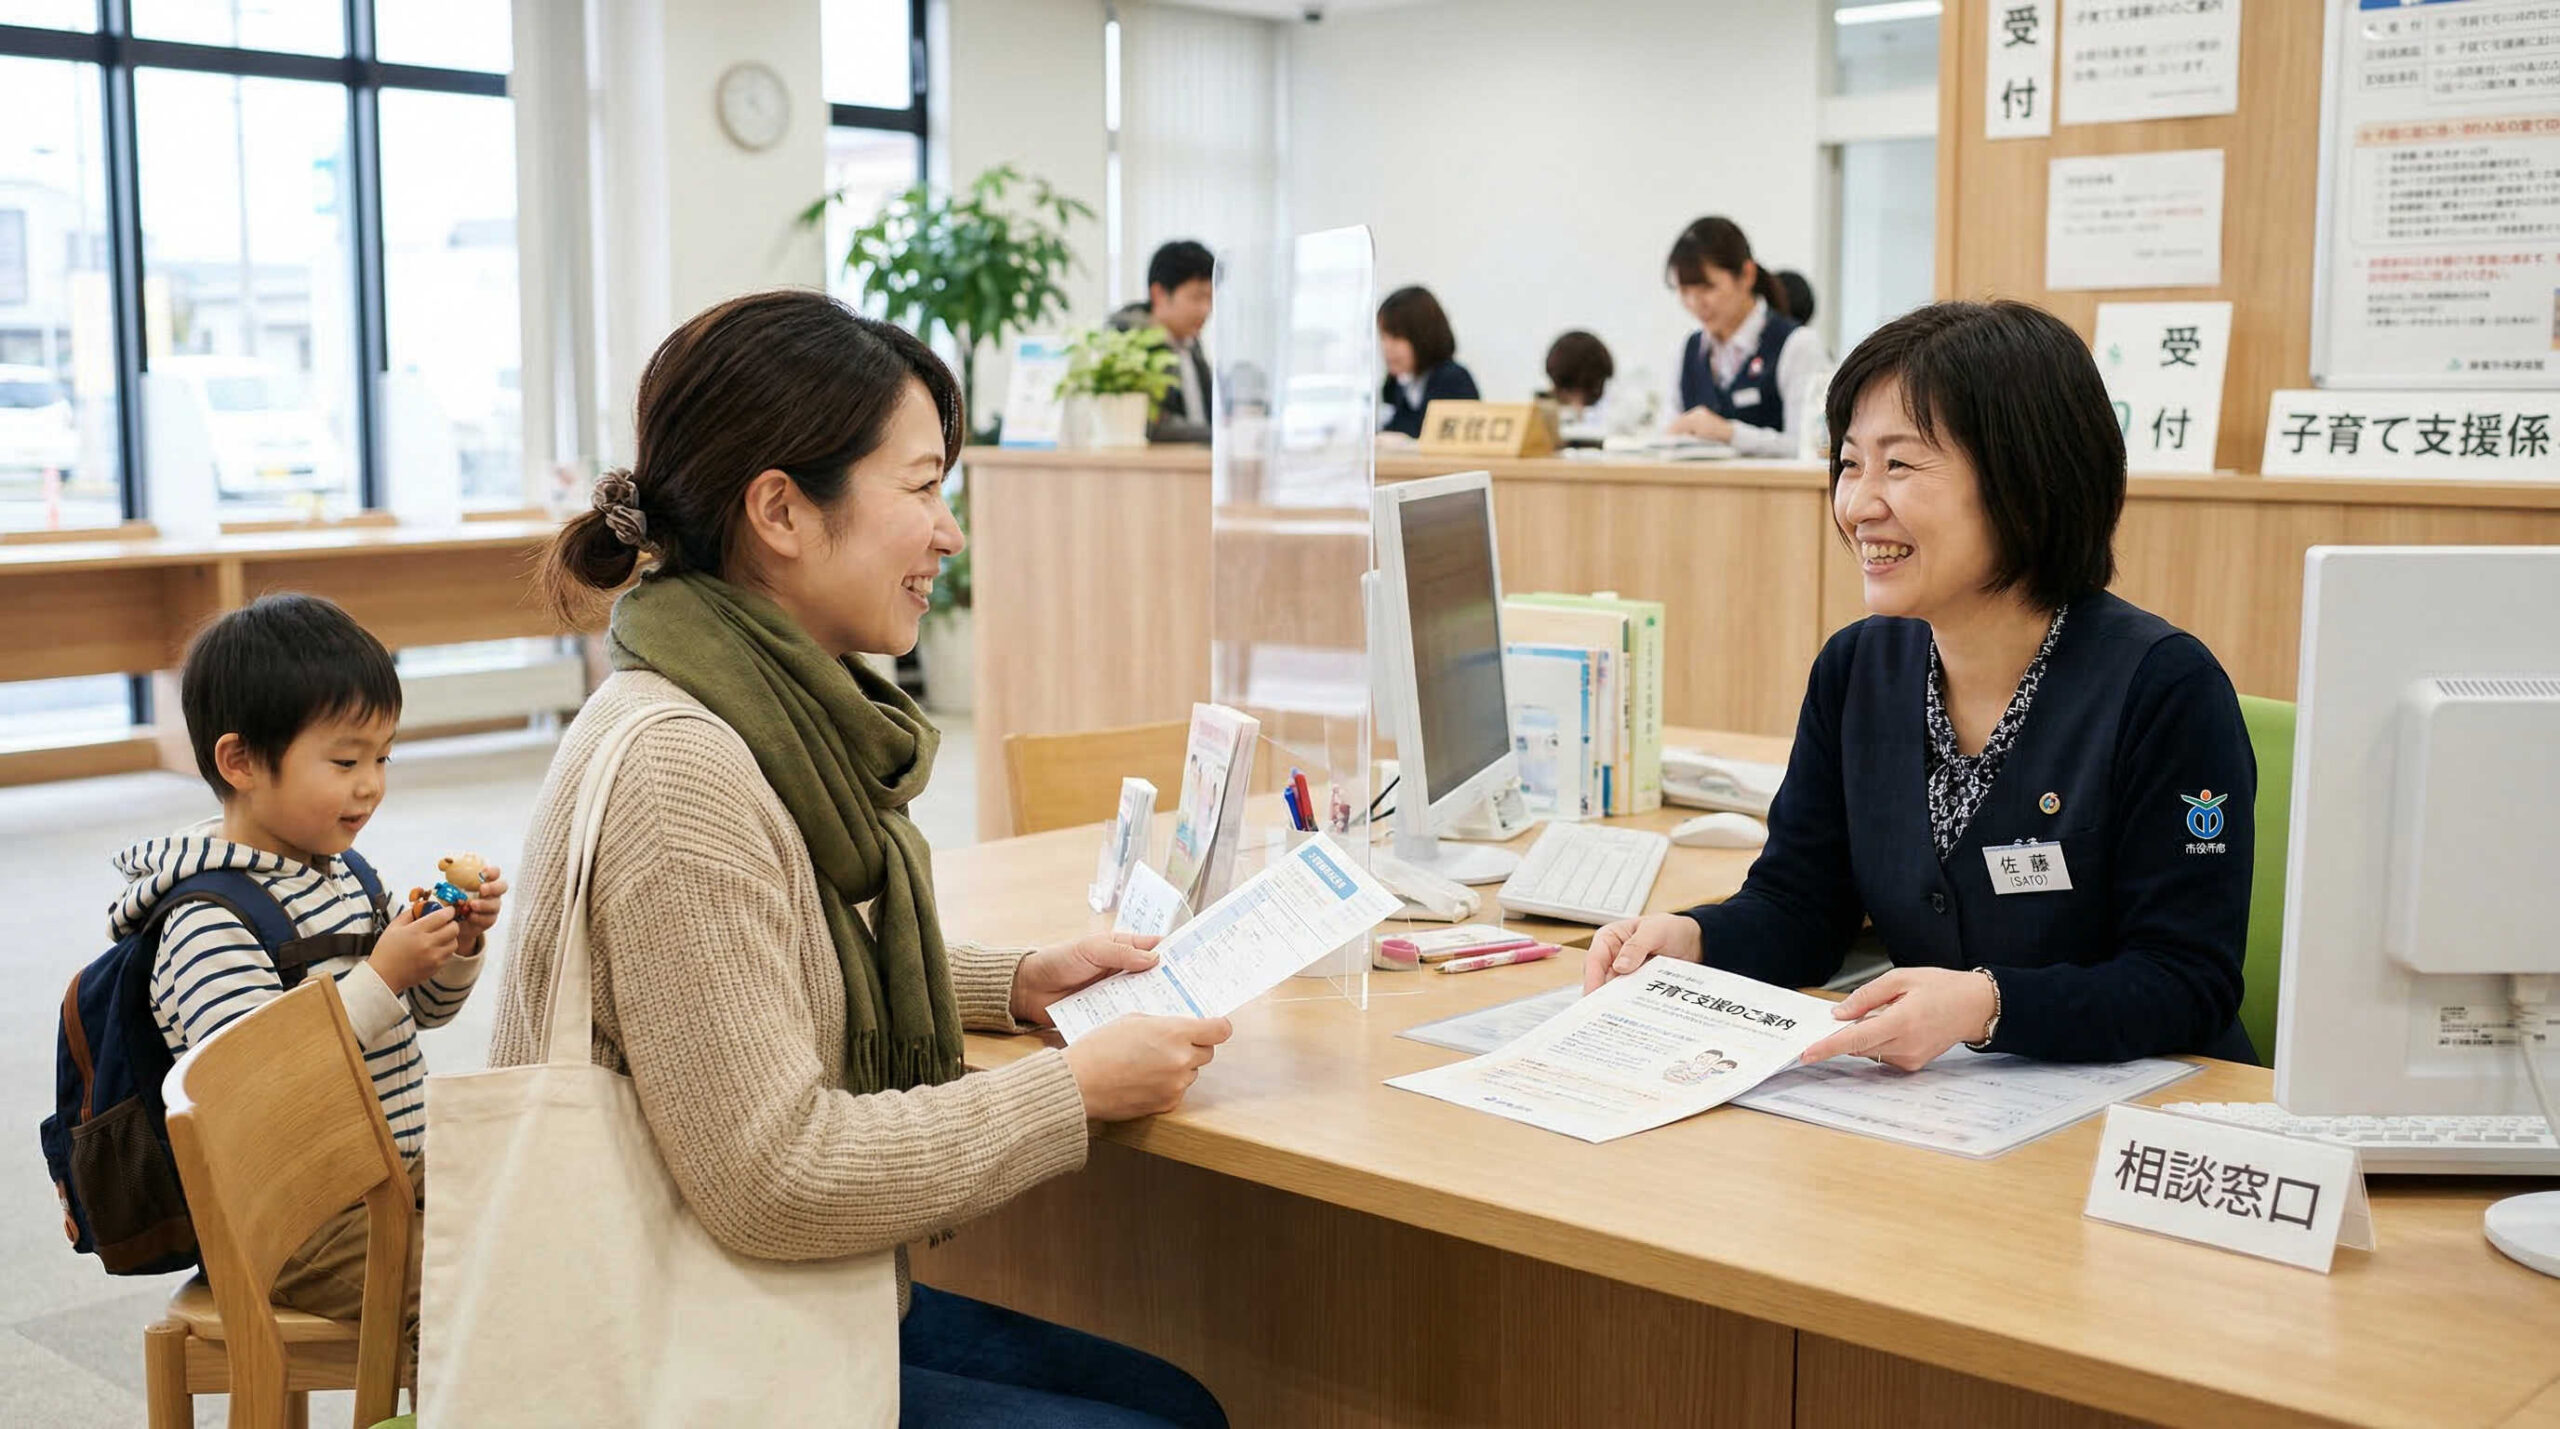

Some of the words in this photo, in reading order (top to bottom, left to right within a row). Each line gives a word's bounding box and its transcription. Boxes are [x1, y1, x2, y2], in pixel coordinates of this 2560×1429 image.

[2001, 5, 2039, 119] 受付
[2152, 326, 2202, 449] 受付
[2282, 413, 2550, 458] 子育て支援係
[2000, 853, 2051, 875] 佐藤
[2010, 874, 2049, 888] (SATO)
[1645, 979, 1798, 1032] 子育て支援のご案内
[2114, 1139, 2322, 1231] 相談窓口
